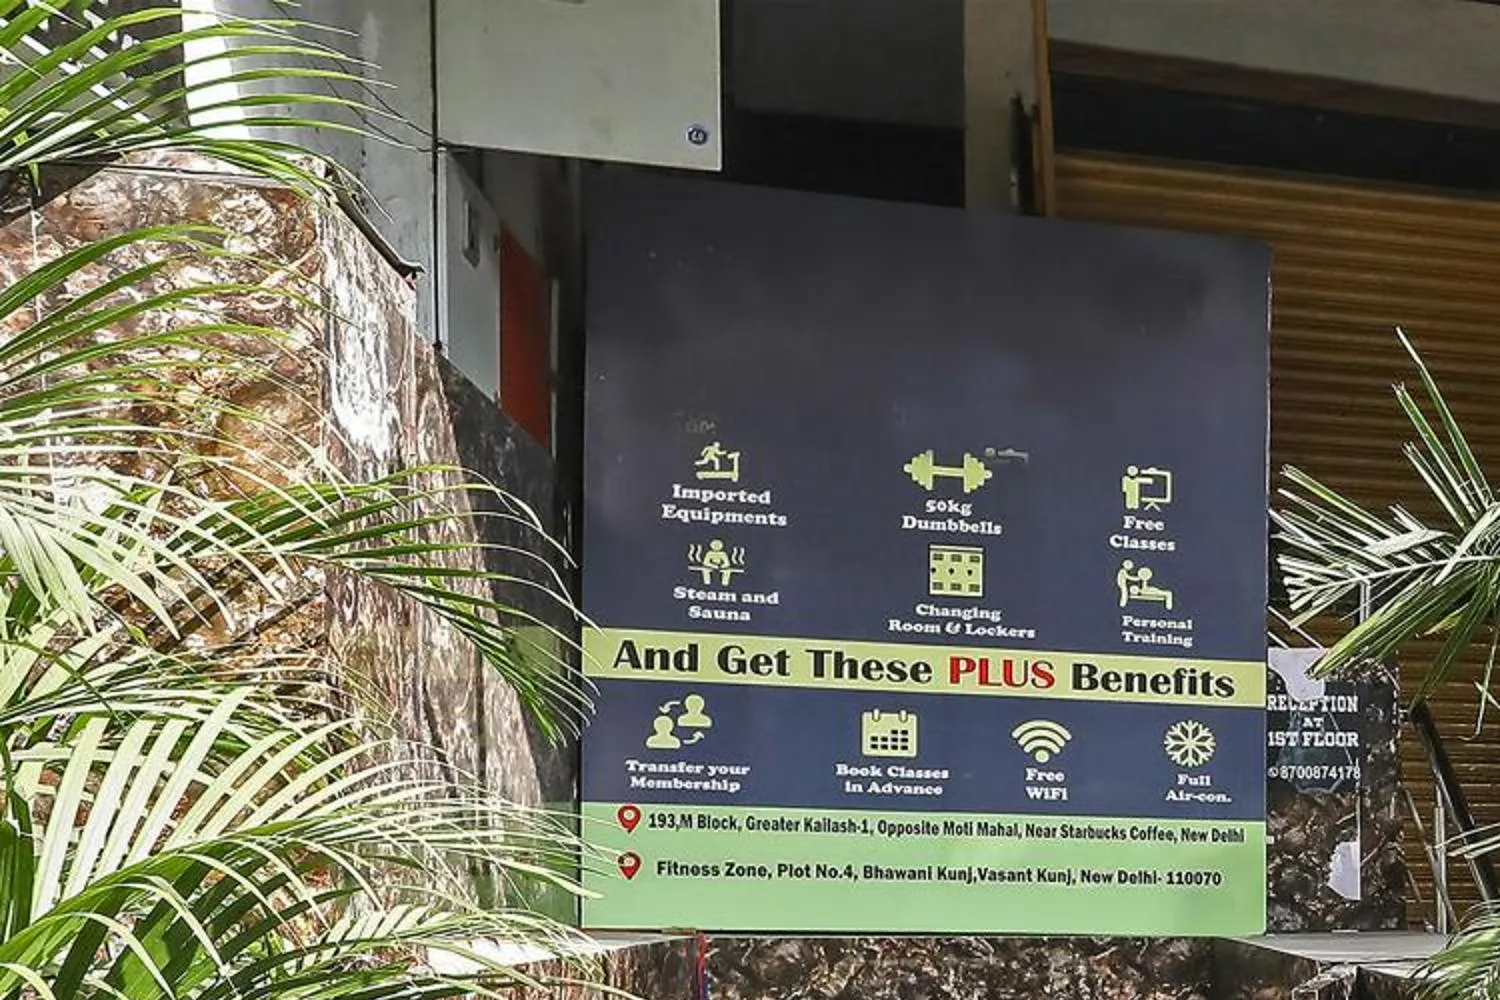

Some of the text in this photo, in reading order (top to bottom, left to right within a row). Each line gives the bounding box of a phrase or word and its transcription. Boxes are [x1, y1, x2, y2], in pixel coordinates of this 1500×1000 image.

[672, 484, 772, 505] Imported
[661, 503, 788, 527] Equipments
[925, 499, 973, 517] 50kg
[901, 515, 1002, 535] Dumbbells
[1122, 515, 1165, 531] Free
[1109, 534, 1177, 551] Classes
[672, 585, 780, 605] Steam and
[687, 605, 752, 621] Sauna
[915, 603, 1002, 623] Changing
[888, 619, 1037, 639] Room & Lockers
[1121, 615, 1193, 630] Personal
[1121, 631, 1194, 648] Training
[612, 639, 1236, 698] And Get These PLUS Benefits
[1301, 717, 1325, 728] AT
[1267, 731, 1360, 748] 1ST FLOOR
[625, 759, 751, 777] Transfer your
[836, 763, 949, 779] Book Classes
[1025, 767, 1065, 783] Free
[629, 775, 741, 793] Membership
[870, 780, 944, 796] Advance
[1176, 773, 1212, 787] Full
[1025, 785, 1068, 801] WiFi
[1165, 790, 1232, 804] Air-con.
[698, 814, 743, 832] Block,
[745, 815, 800, 832] Greater
[877, 818, 939, 838] Opposite
[942, 821, 973, 836] Moti
[976, 821, 1023, 840] Mahal,
[1025, 823, 1057, 838] Near
[1059, 824, 1127, 841] Starbucks
[1129, 826, 1178, 843] Coffee,
[1180, 827, 1208, 843] New
[1211, 828, 1245, 843] Delhi
[656, 861, 720, 877] Fitness
[724, 862, 773, 880] Zone,
[777, 863, 811, 879] Plot
[815, 864, 859, 882] No.4,
[863, 865, 933, 881] Bhawani
[1036, 867, 1077, 886] Kunj,
[1080, 869, 1114, 884] New
[1166, 871, 1223, 886] 110070
